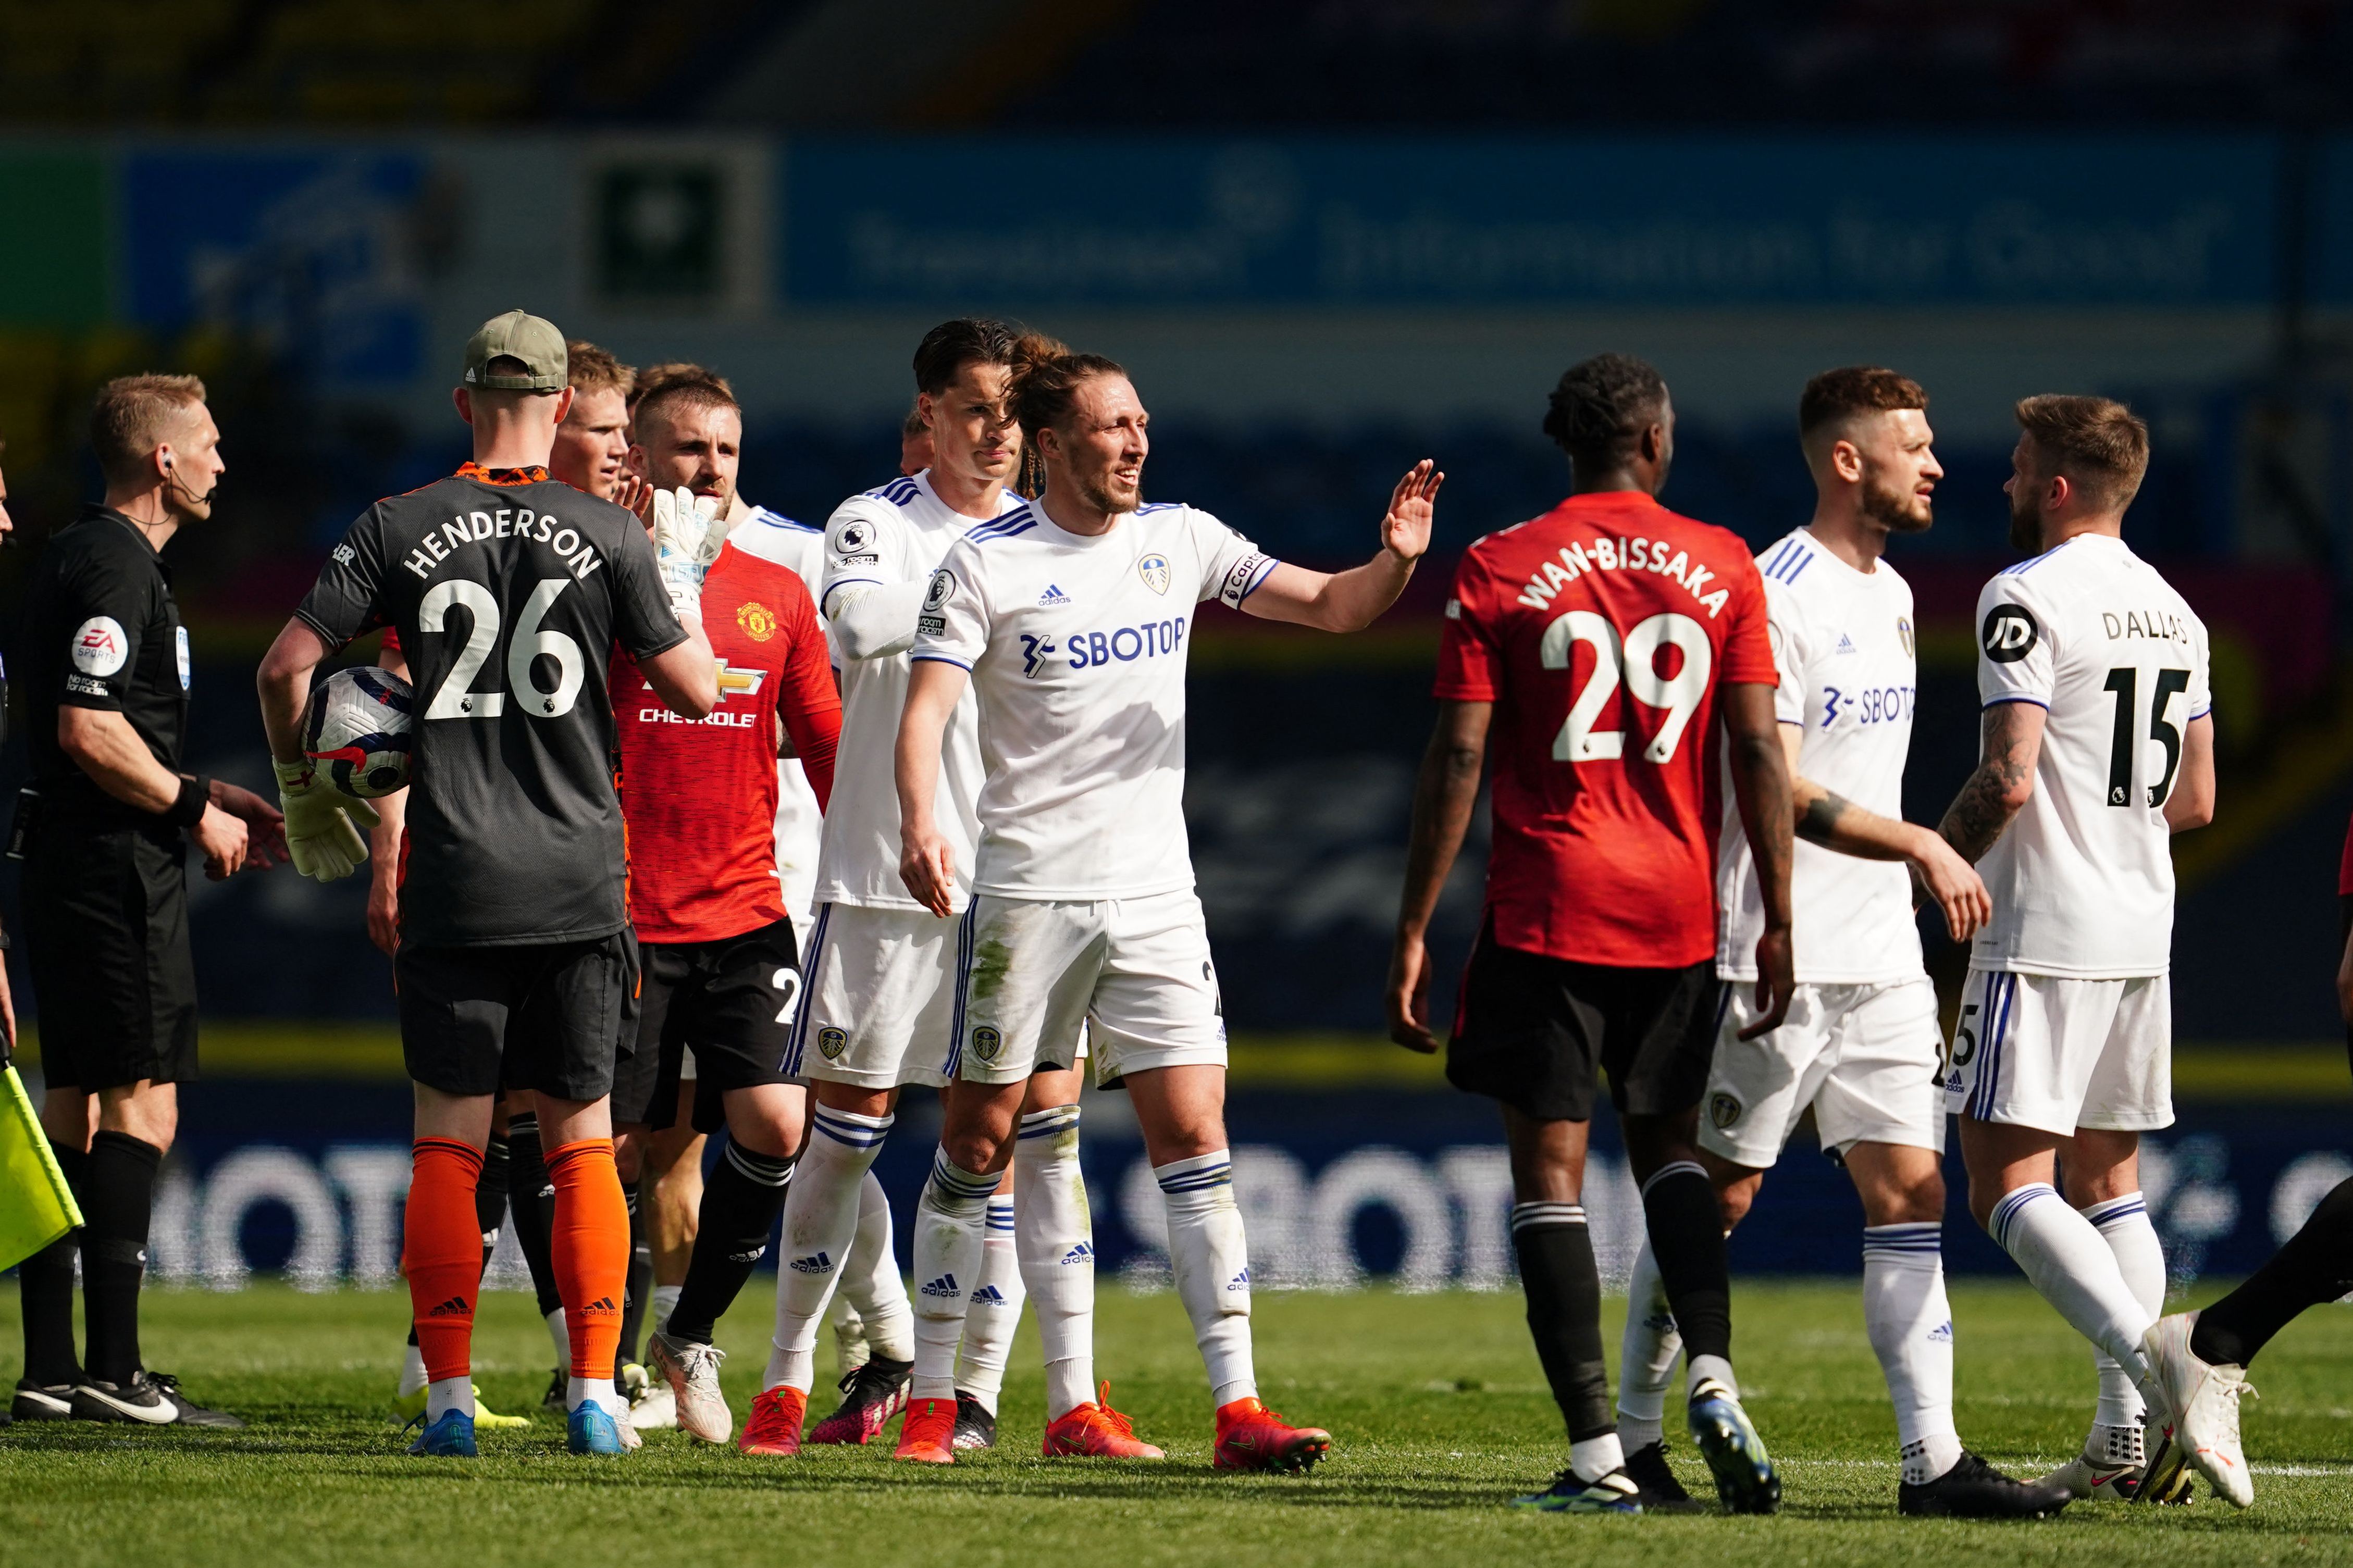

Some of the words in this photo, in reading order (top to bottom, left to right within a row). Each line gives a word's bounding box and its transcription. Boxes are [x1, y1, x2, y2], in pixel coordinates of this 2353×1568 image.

[403, 509, 603, 579] HENDERSON
[1517, 536, 1729, 619] WAN-BISSAKA
[1038, 596, 1071, 606] adidas
[921, 618, 942, 627] room
[1987, 617, 2032, 650] JD
[2102, 610, 2188, 644] DALLAS
[78, 647, 116, 664] SPORTS
[80, 629, 115, 654] EA
[419, 579, 585, 719] 26
[1068, 617, 1185, 669] SBOTOP
[68, 673, 81, 685] No
[1540, 610, 1712, 764] 29
[2103, 667, 2192, 808] 15
[772, 967, 802, 1025] 2
[1953, 1004, 1979, 1066] 5
[790, 1262, 834, 1274] adidas
[921, 1285, 961, 1297] adidas
[970, 1295, 1009, 1306] adidas
[429, 1307, 472, 1316] adidas
[580, 1307, 620, 1316] adidas
